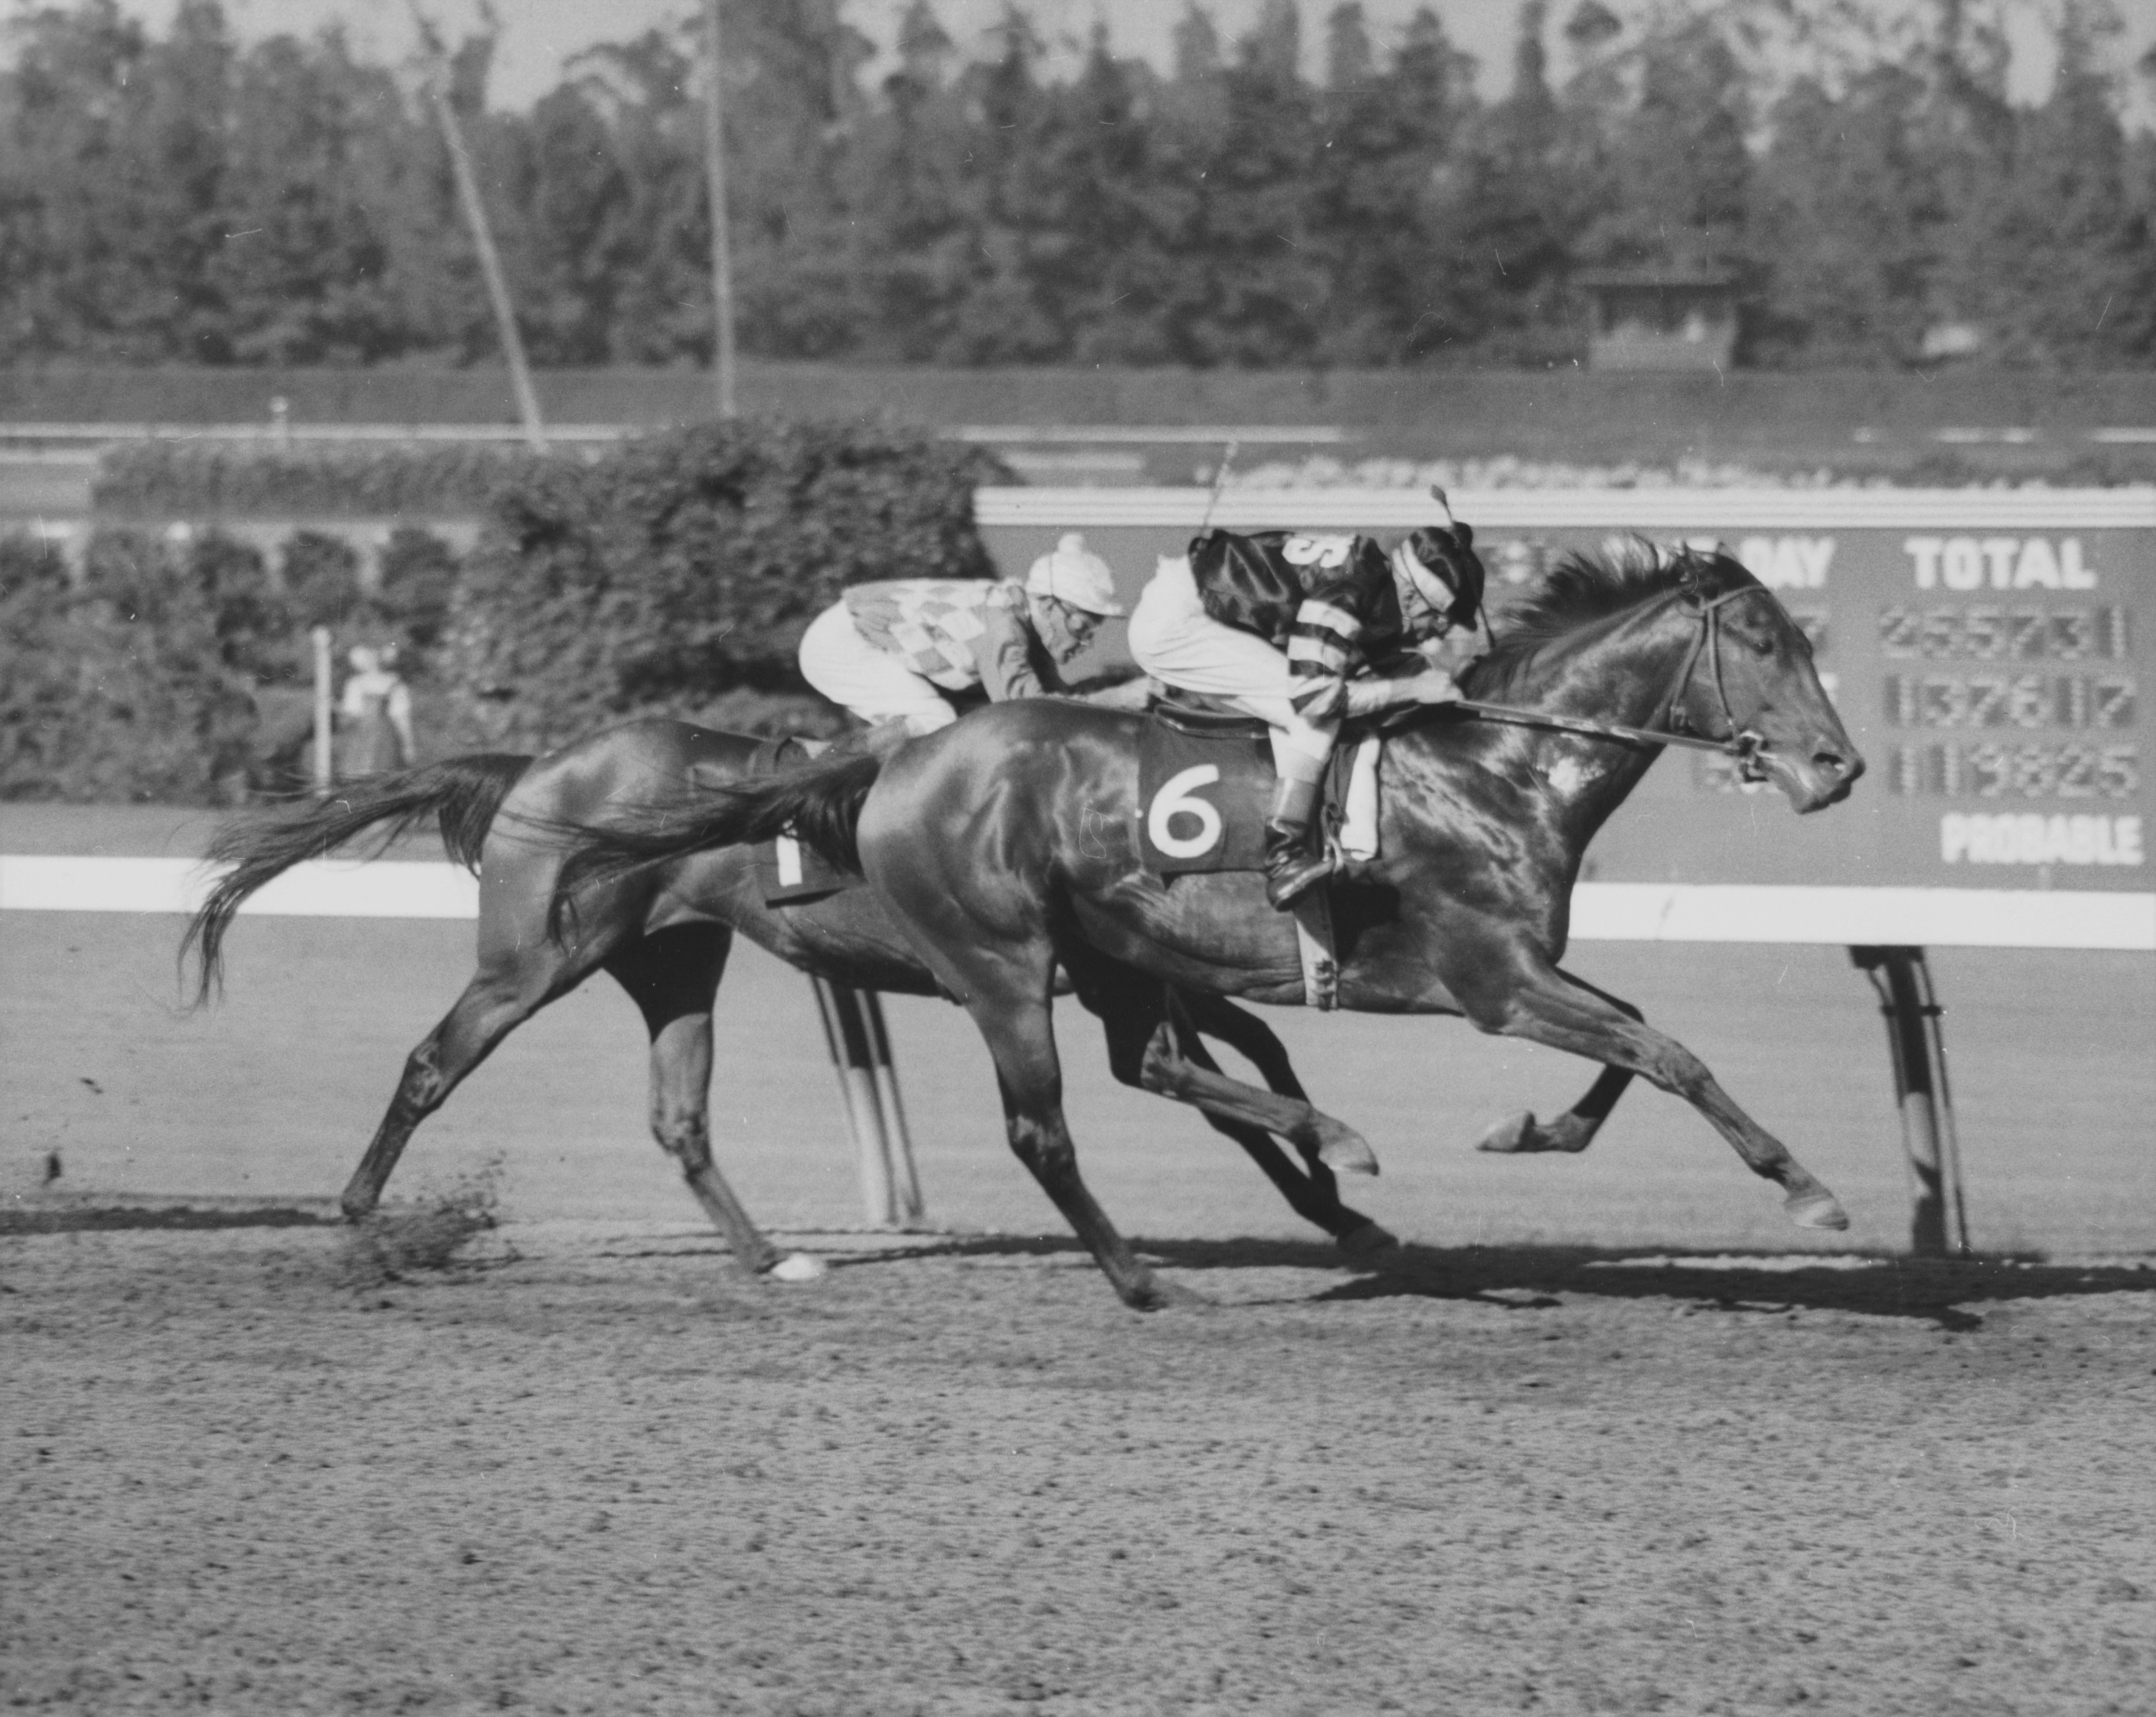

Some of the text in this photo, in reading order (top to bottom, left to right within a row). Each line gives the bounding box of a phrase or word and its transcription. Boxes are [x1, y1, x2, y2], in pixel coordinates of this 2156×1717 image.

[1905, 538, 2096, 590] TOTAL
[1879, 606, 2126, 659] 255731
[1898, 675, 2137, 728] 137617
[1149, 765, 1221, 858] 6
[1940, 812, 2143, 865] PROBABLE
